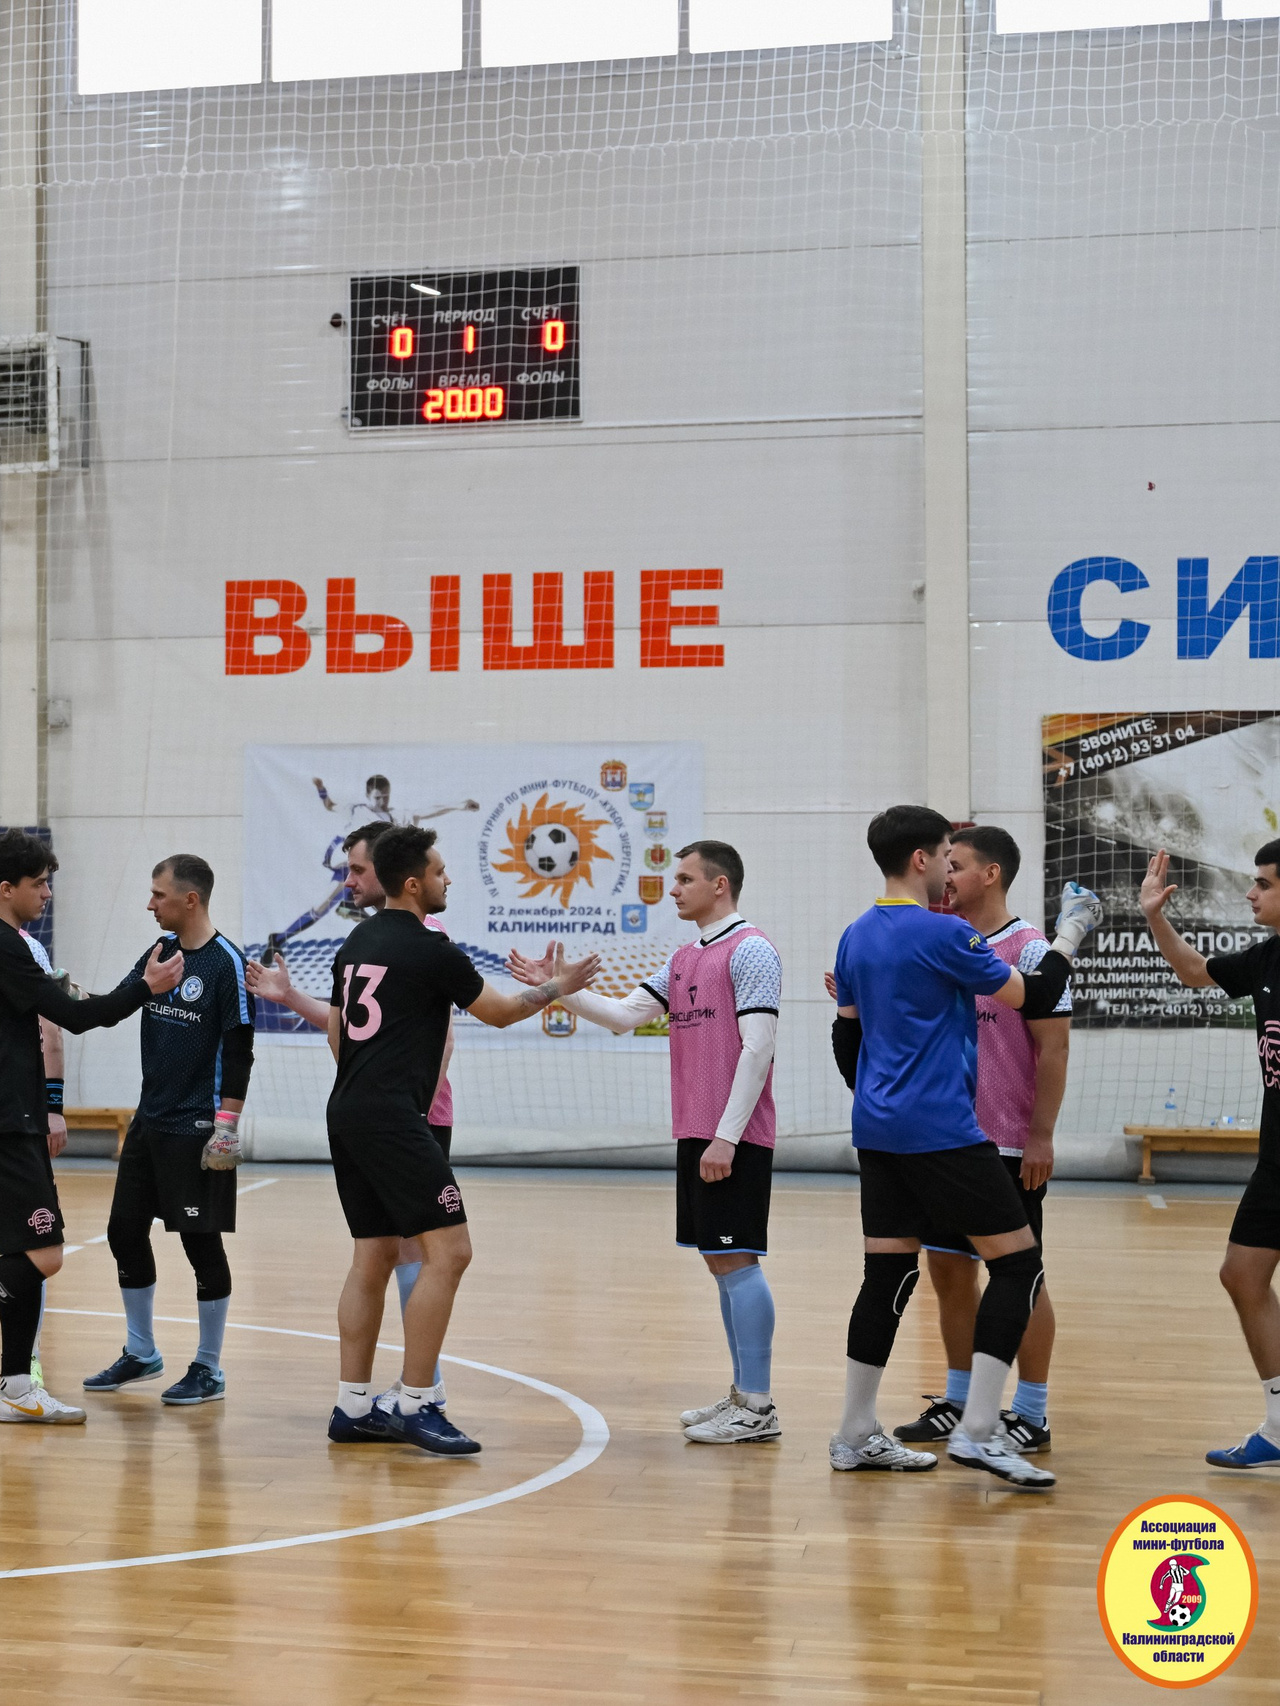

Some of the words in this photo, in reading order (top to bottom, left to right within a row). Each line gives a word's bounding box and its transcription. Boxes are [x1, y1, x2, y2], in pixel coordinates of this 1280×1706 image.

[433, 308, 495, 324] ПЕРИОД
[391, 327, 413, 359] 0
[542, 320, 564, 352] 0
[366, 376, 413, 391] ФОЛЫ
[439, 373, 491, 388] ВРЕМЯ
[516, 370, 565, 385] ФОЛЫ
[225, 568, 725, 676] ВЫШЕ
[1079, 718, 1157, 752] ЗВОНИТЕ:
[1058, 763, 1075, 778] +7
[1079, 746, 1129, 774] (4012)
[1130, 739, 1150, 755] 93
[1152, 732, 1172, 748] 31
[1174, 724, 1196, 741] 04
[489, 906, 505, 916] 22
[509, 906, 565, 917] декабря
[570, 906, 602, 916] 2024
[488, 921, 616, 935] КАЛИНИНГРАД
[1097, 931, 1159, 952] ИЛА
[1075, 972, 1084, 984] В
[1087, 972, 1182, 985] КАЛИНИНГРА
[1160, 1002, 1202, 1017] (4012)
